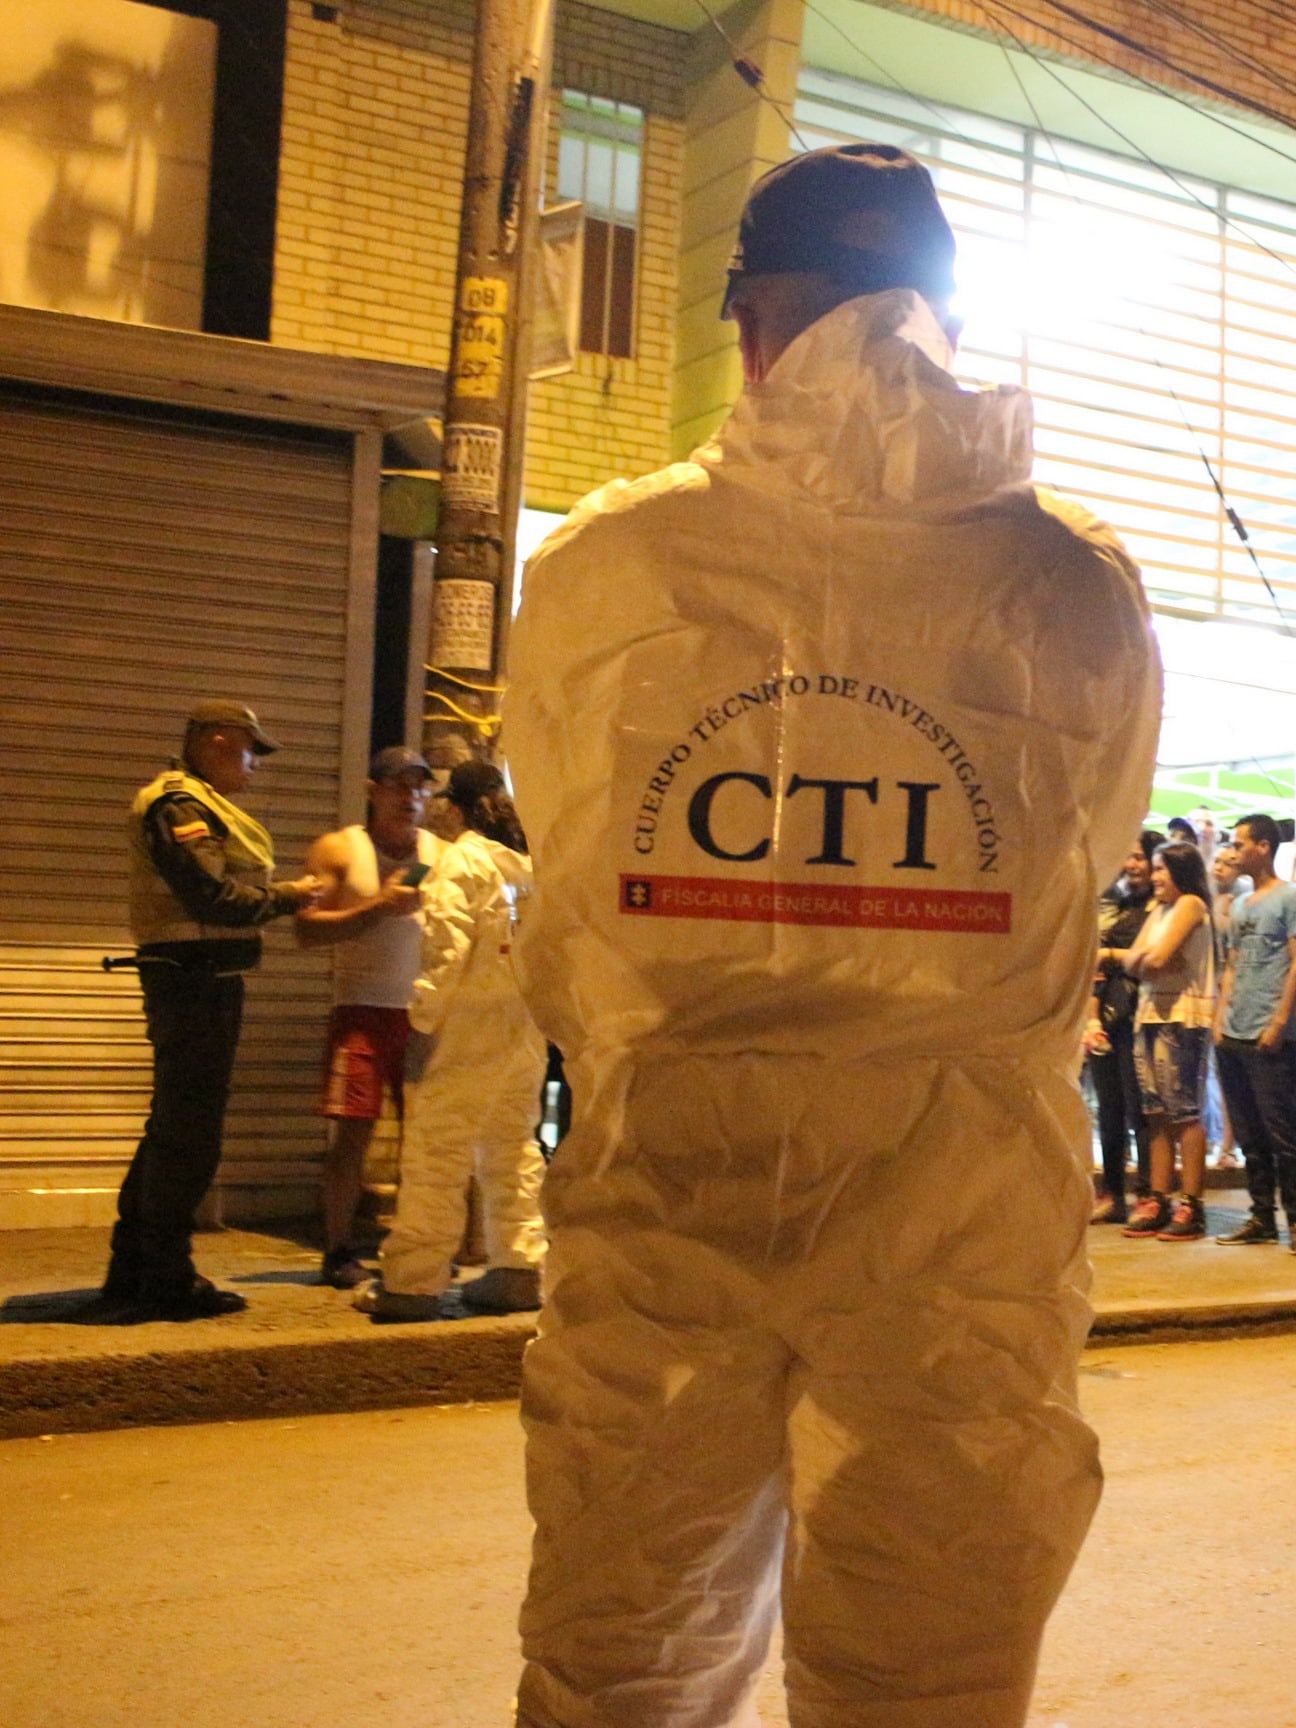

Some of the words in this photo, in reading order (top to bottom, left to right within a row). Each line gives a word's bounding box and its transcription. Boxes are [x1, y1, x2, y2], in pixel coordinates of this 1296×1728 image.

[634, 744, 691, 855] CUERPO
[818, 674, 860, 700] DE
[865, 684, 1002, 874] INVESTIGACIÓN
[687, 770, 942, 870] CTI
[757, 893, 853, 915] GENERAL
[859, 898, 887, 917] DE
[894, 899, 921, 918] LA
